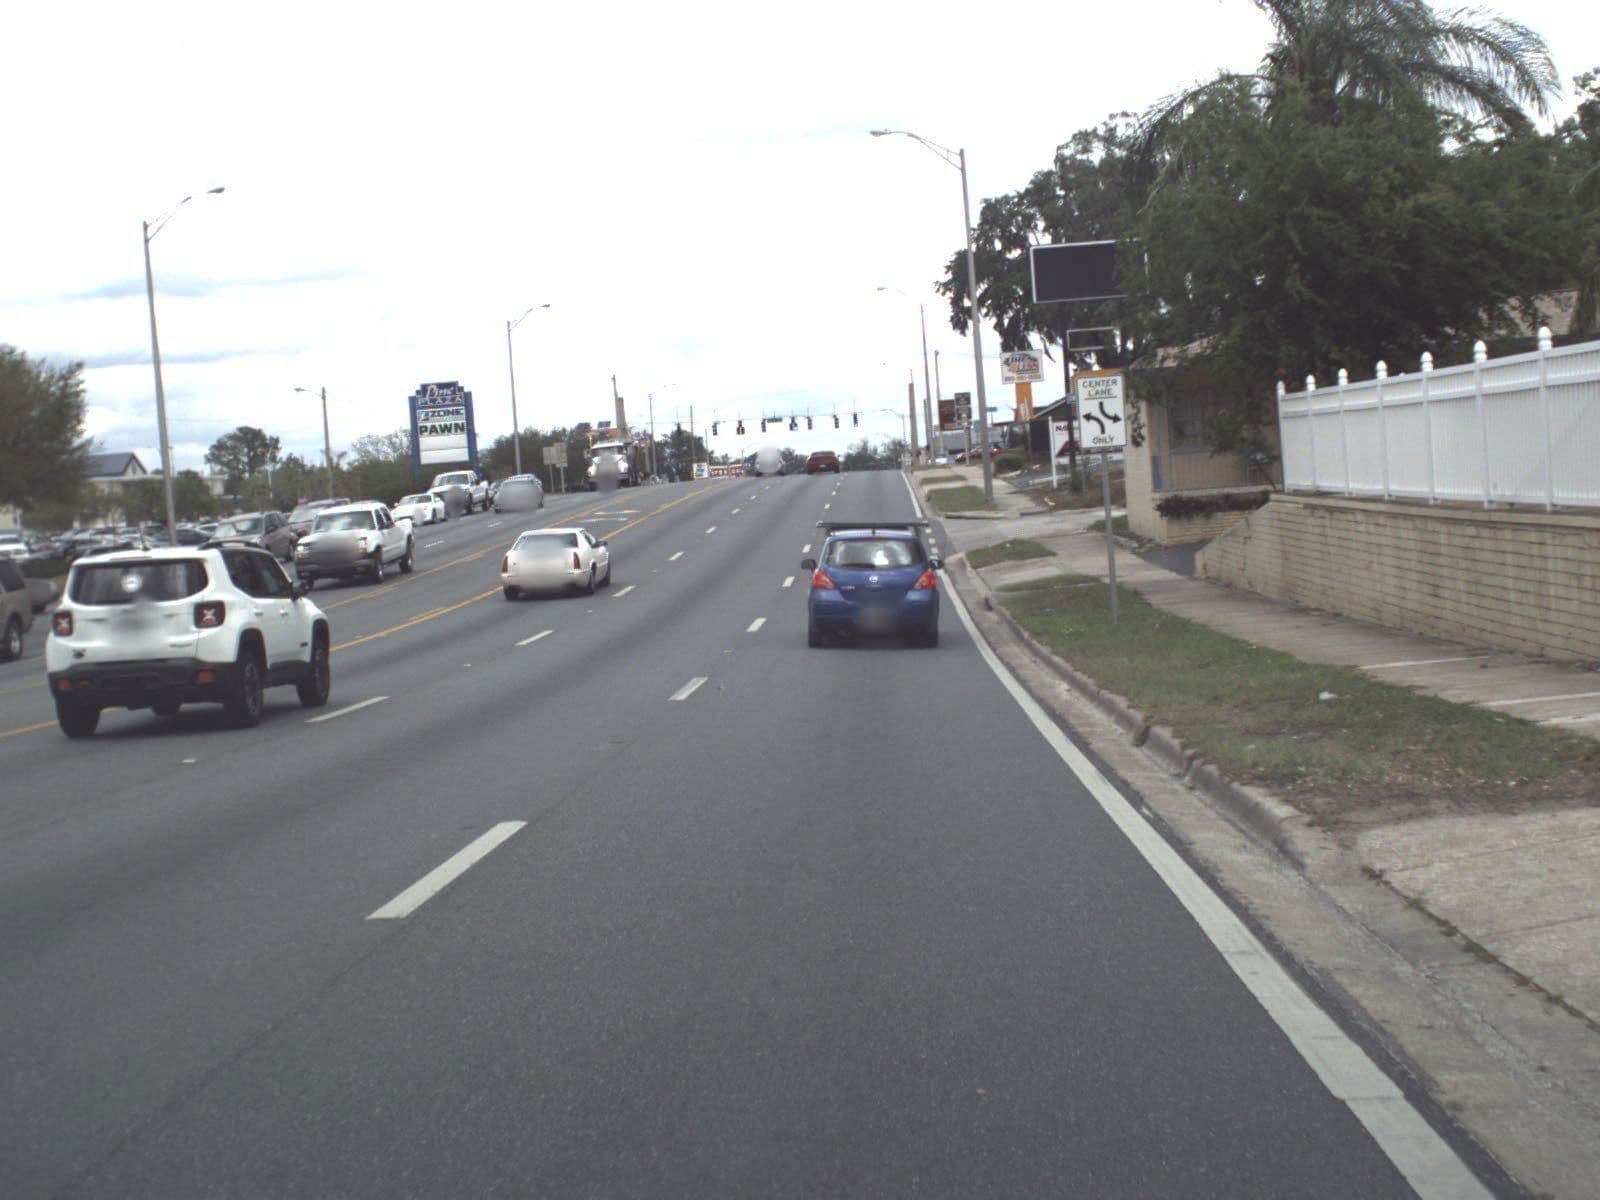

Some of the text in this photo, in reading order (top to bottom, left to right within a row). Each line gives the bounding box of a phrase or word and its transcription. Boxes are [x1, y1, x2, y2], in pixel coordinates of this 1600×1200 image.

[1082, 379, 1118, 388] CENTER
[1088, 388, 1113, 397] LANE
[419, 423, 465, 435] PAWN
[1092, 434, 1115, 445] ONLY
